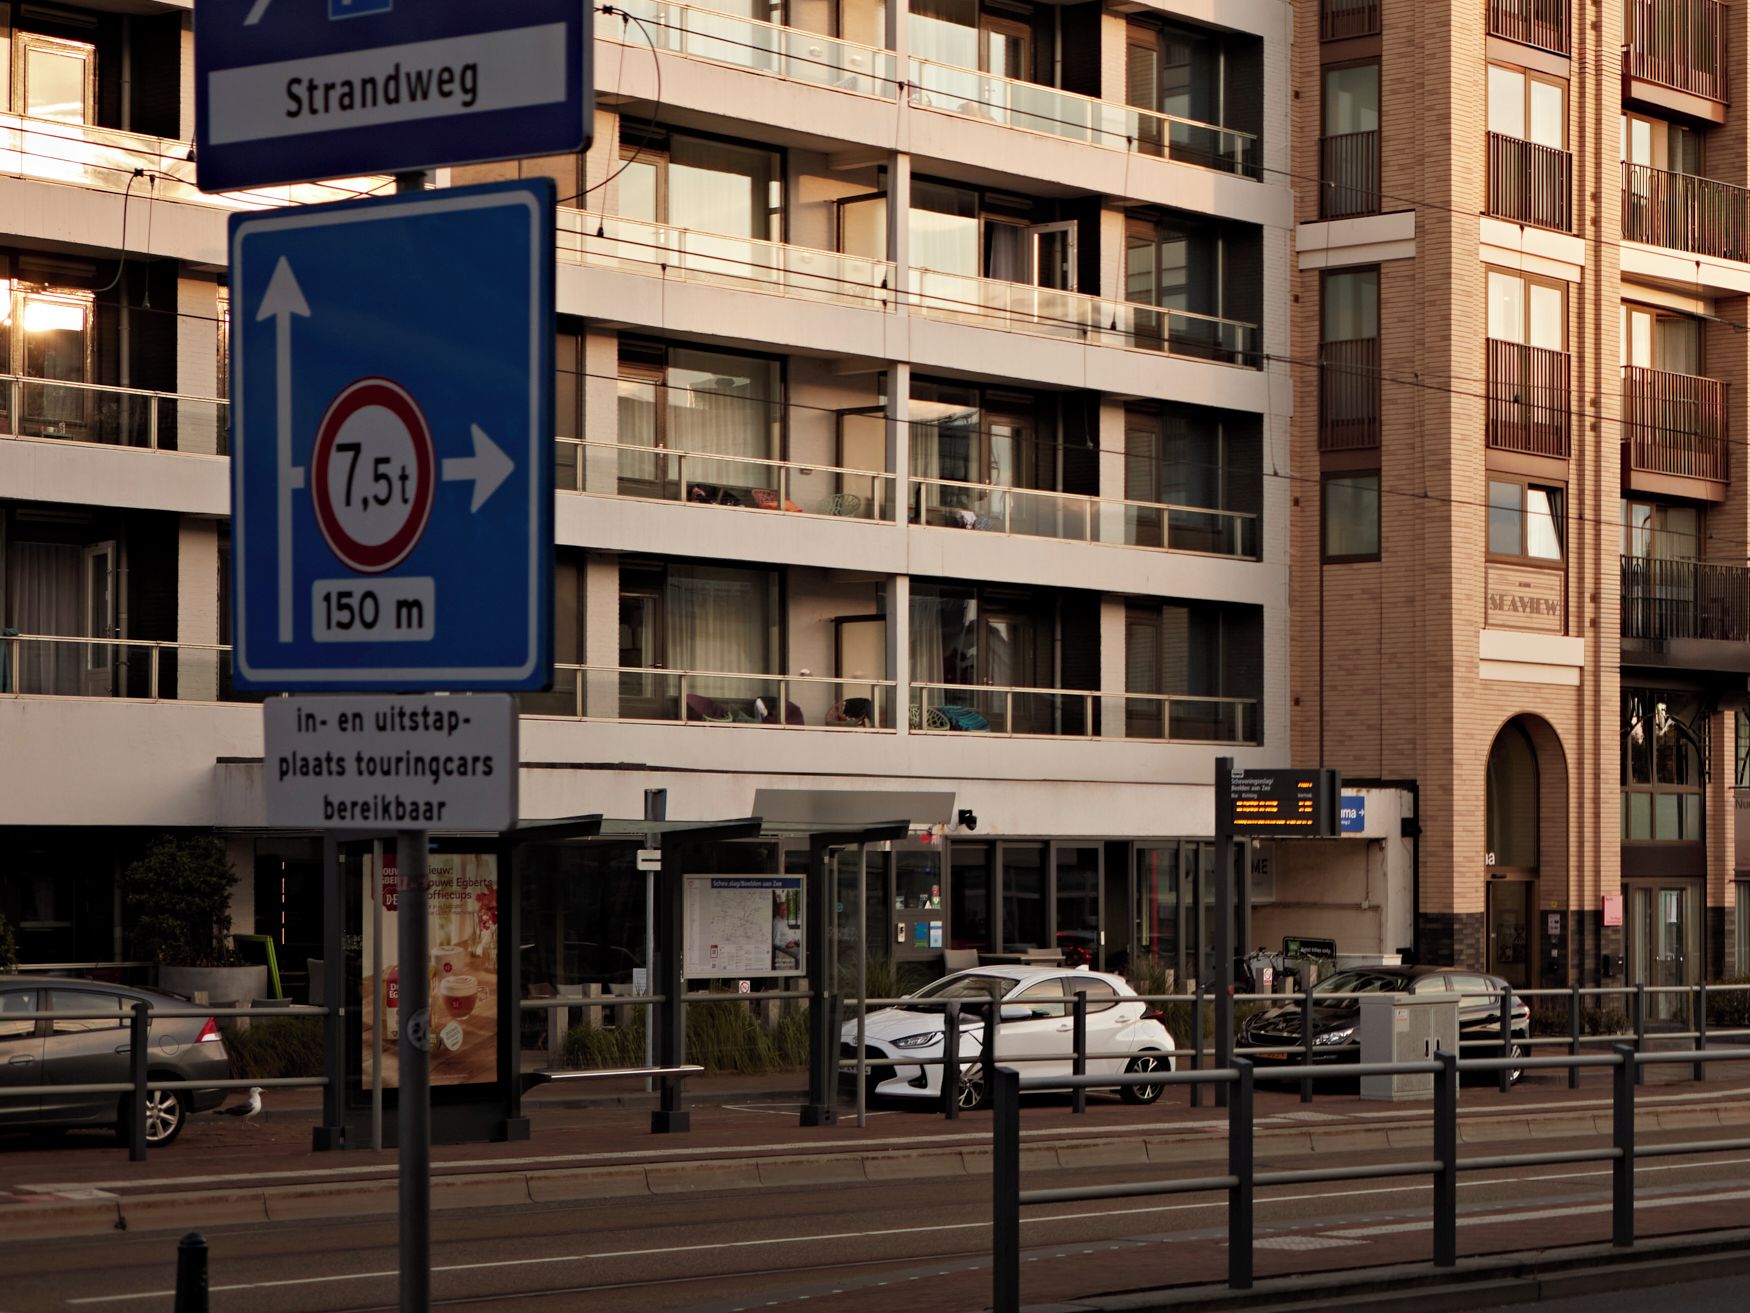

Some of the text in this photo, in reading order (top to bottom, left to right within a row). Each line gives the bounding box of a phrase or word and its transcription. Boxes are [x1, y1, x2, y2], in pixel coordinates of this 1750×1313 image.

[285, 62, 478, 119] Strandweg
[323, 590, 425, 631] 150 m
[1489, 593, 1559, 616] SEAVIEW
[296, 705, 472, 738] in- en uitstap-
[279, 750, 494, 784] plaats touringcars
[323, 793, 446, 822] bereikbaar
[427, 879, 455, 890] ouwe
[456, 877, 494, 891] Egberts
[428, 865, 453, 875] ieuw:
[427, 890, 472, 901] offiecups
